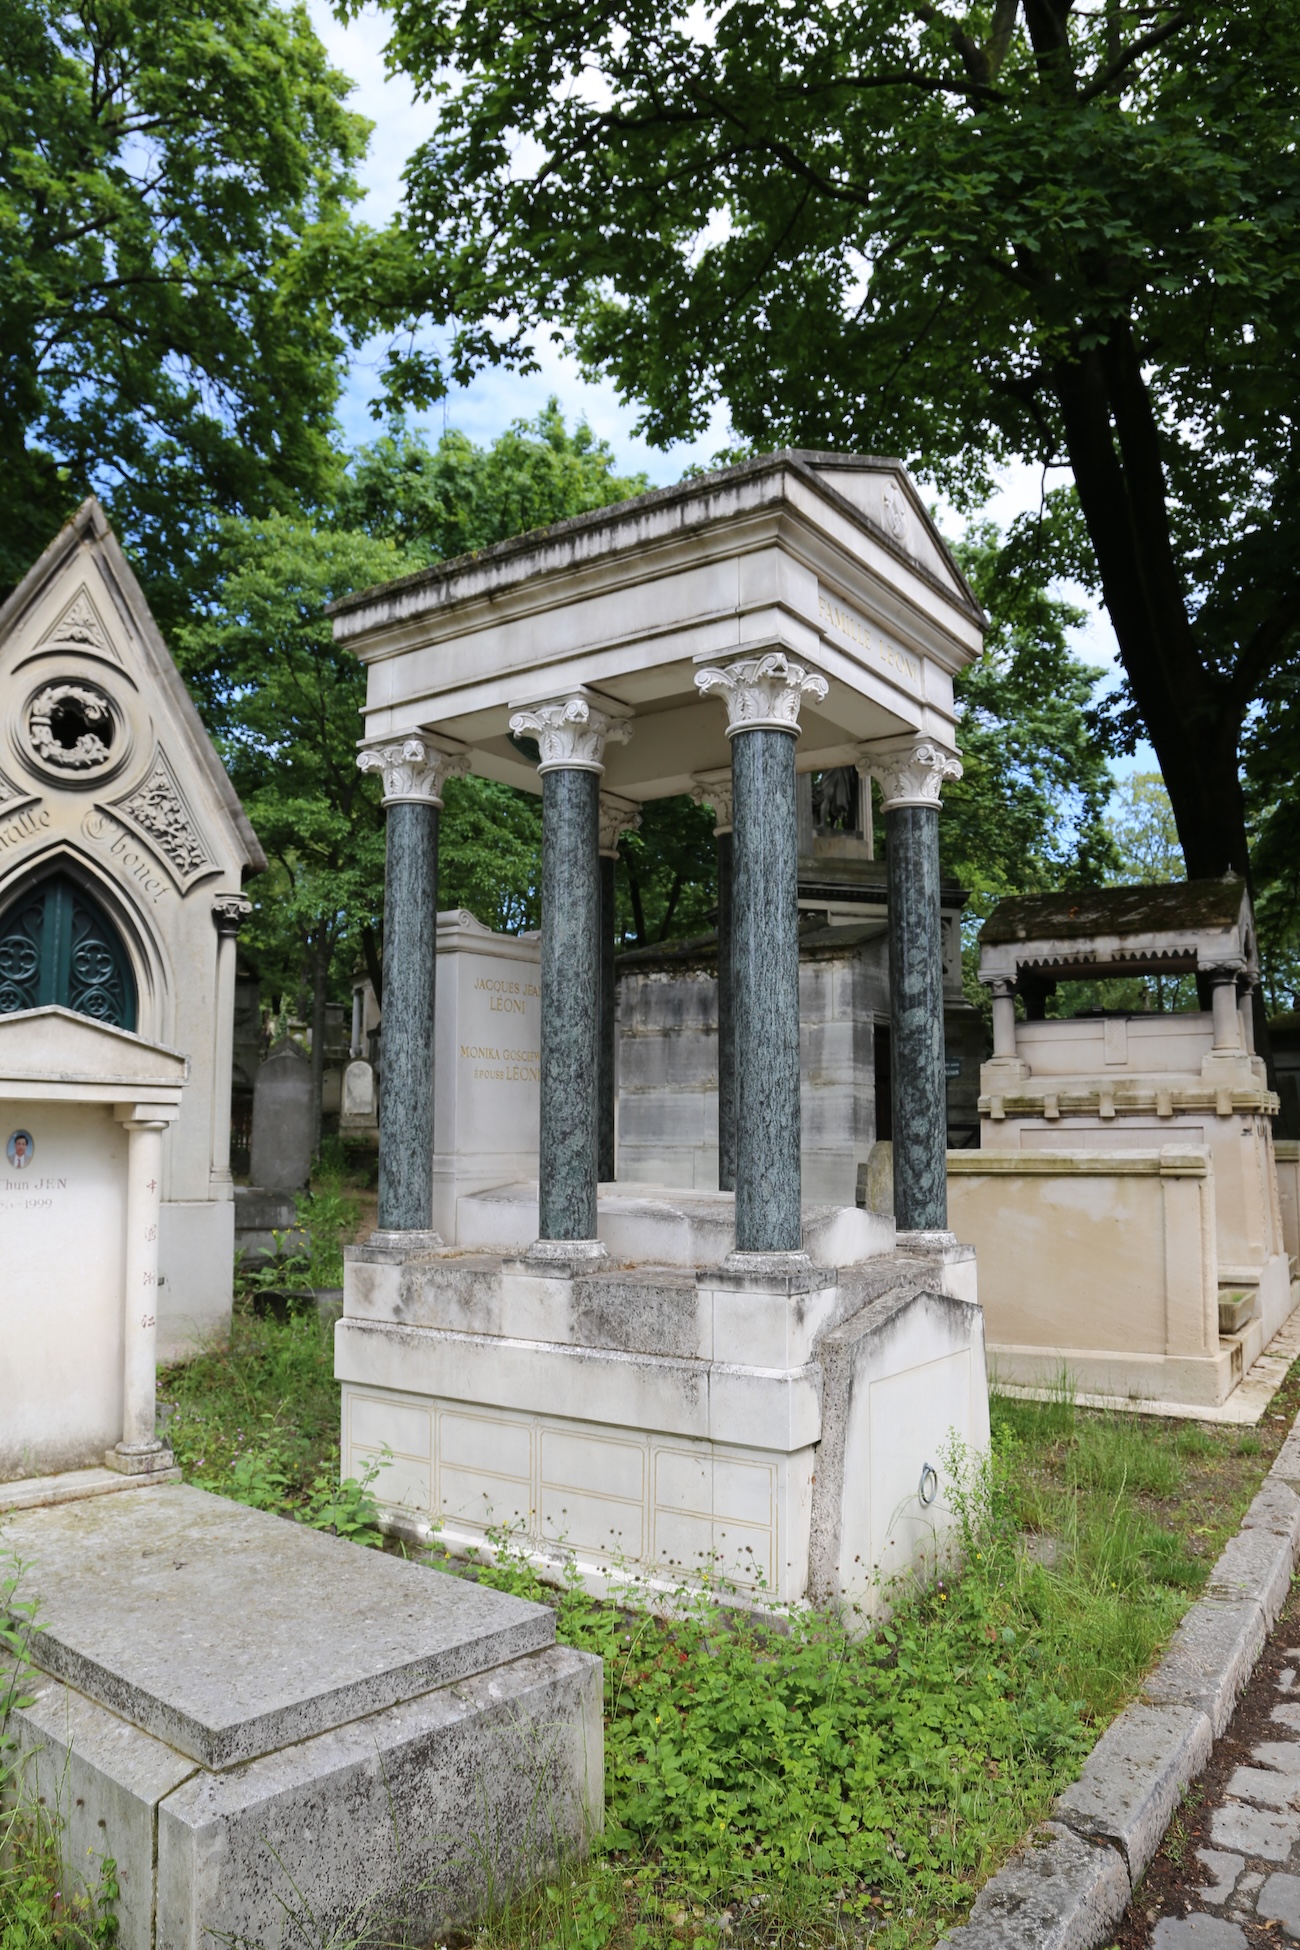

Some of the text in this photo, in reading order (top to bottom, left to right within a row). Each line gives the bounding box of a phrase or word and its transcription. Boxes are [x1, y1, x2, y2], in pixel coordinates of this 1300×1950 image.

[818, 596, 871, 651] FAMILLE
[474, 978, 520, 995] JACQUES
[490, 995, 525, 1014] LÉONI
[461, 1045, 501, 1060] MONIKA
[474, 1067, 504, 1080] ÉPOUSE
[34, 1178, 67, 1190] JEN
